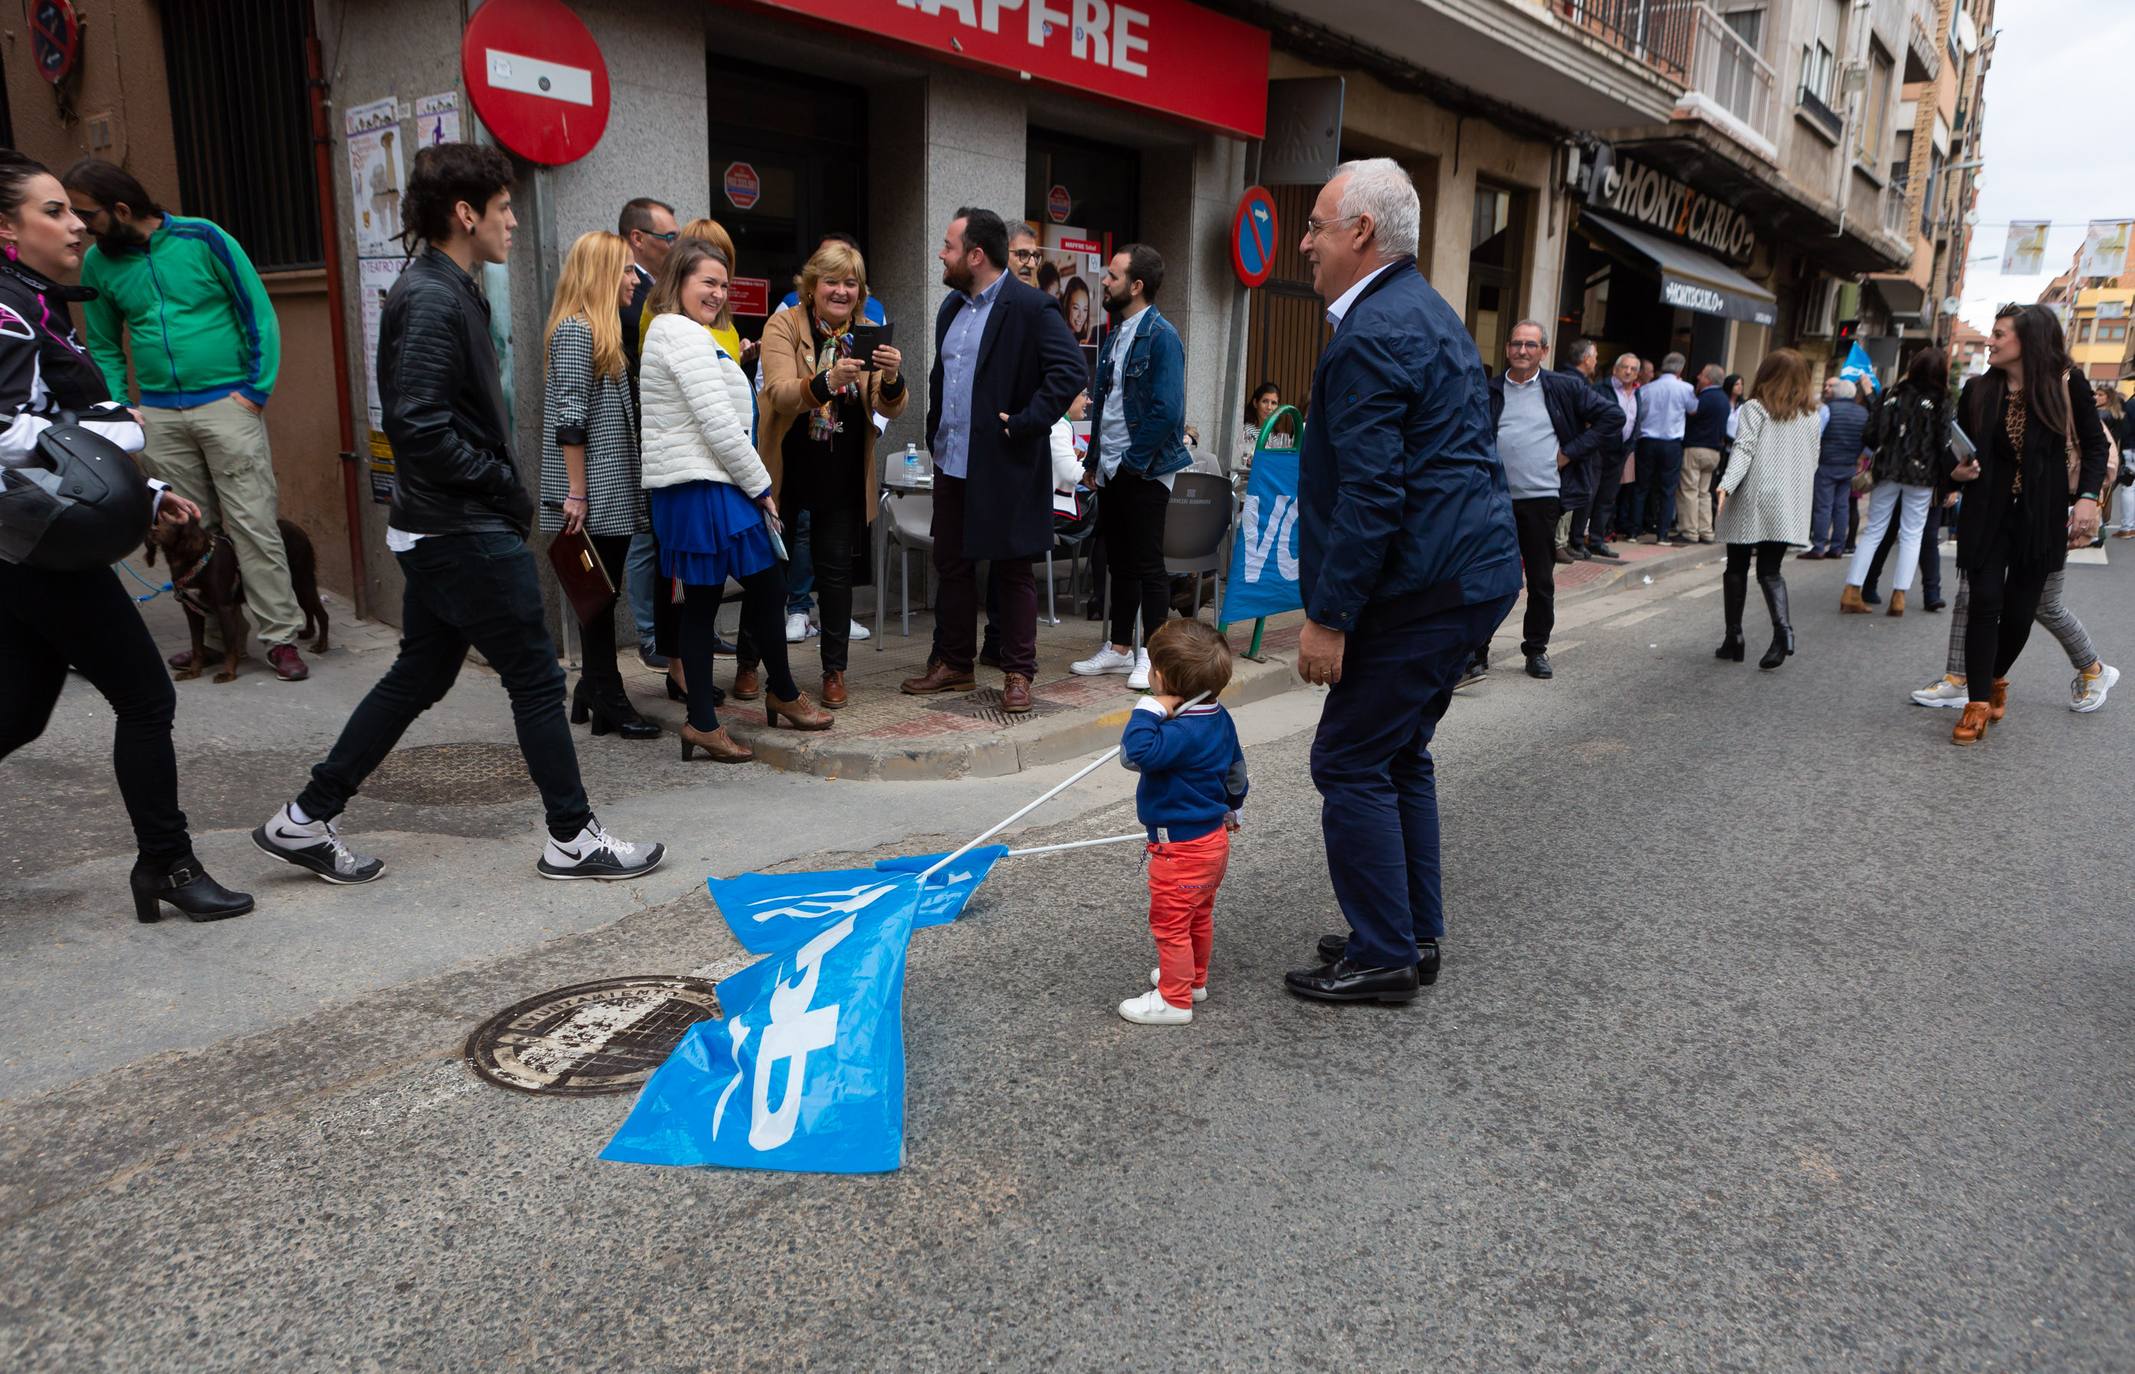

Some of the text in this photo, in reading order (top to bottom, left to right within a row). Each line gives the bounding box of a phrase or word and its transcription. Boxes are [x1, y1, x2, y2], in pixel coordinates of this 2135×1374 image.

[897, 0, 1150, 78] PFRE
[1613, 157, 1748, 257] MONTECARLO
[1667, 281, 1719, 312] MONTECARLO
[517, 988, 680, 1029] AYUNTAMIENTO
